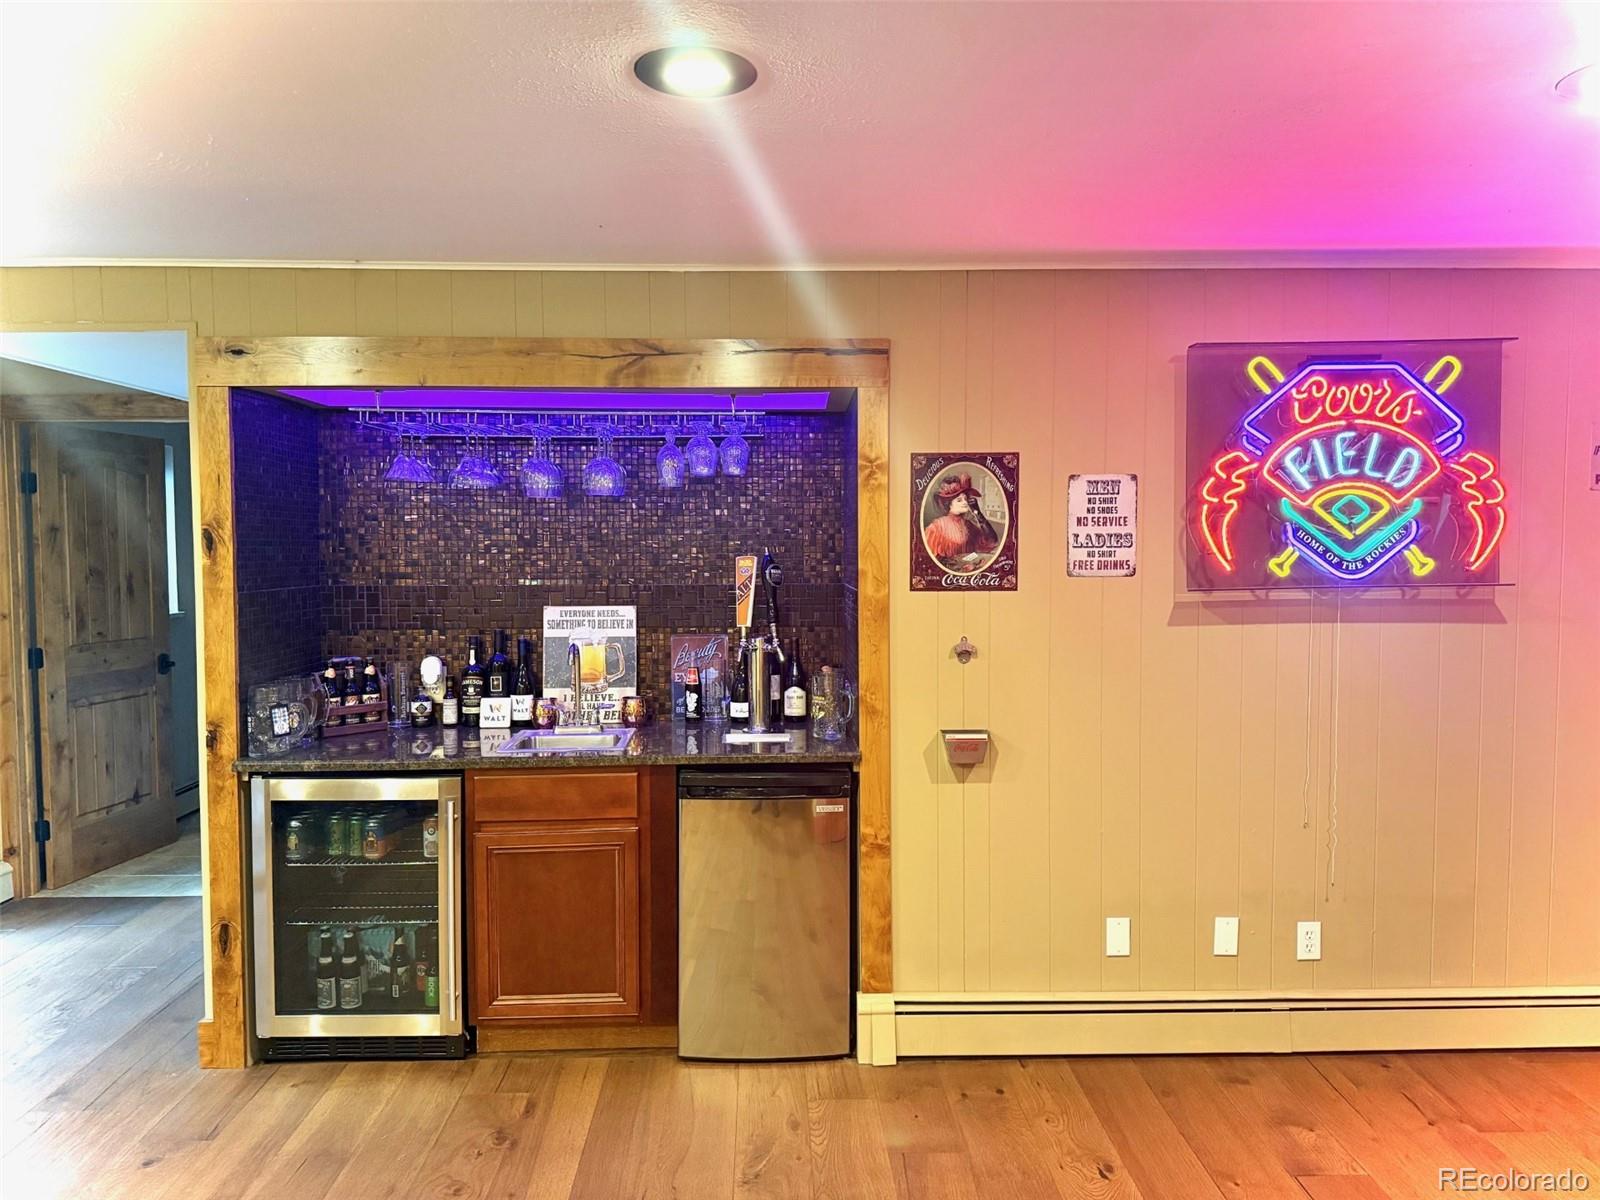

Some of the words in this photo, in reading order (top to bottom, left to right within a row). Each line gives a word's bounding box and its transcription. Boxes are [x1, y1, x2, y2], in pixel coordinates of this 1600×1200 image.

[1291, 376, 1421, 424] Coors
[1283, 430, 1421, 490] FIELD
[1086, 480, 1121, 495] MEN
[1087, 497, 1097, 505] NO
[1098, 497, 1118, 505] SHIRT
[1086, 506, 1096, 514] NO
[1097, 506, 1118, 514] SHOES
[1076, 516, 1089, 527] NO
[1091, 516, 1128, 527] SERVICE
[1072, 533, 1133, 549] LADIES
[1087, 550, 1096, 558] NO
[1097, 550, 1117, 558] SHIRT
[1296, 529, 1326, 554] HOME
[1325, 552, 1340, 565] OF
[1341, 560, 1364, 570] THE
[1365, 527, 1407, 563] ROCKIES
[1073, 560, 1095, 571] FREE
[1097, 560, 1131, 571] DRINKS
[942, 572, 1001, 588] Coca-Cola
[560, 609, 596, 618] EVERYONE
[547, 619, 586, 629] SOMETHING
[587, 619, 596, 629] TO
[597, 619, 625, 629] BELIEVE
[626, 619, 634, 629] IN
